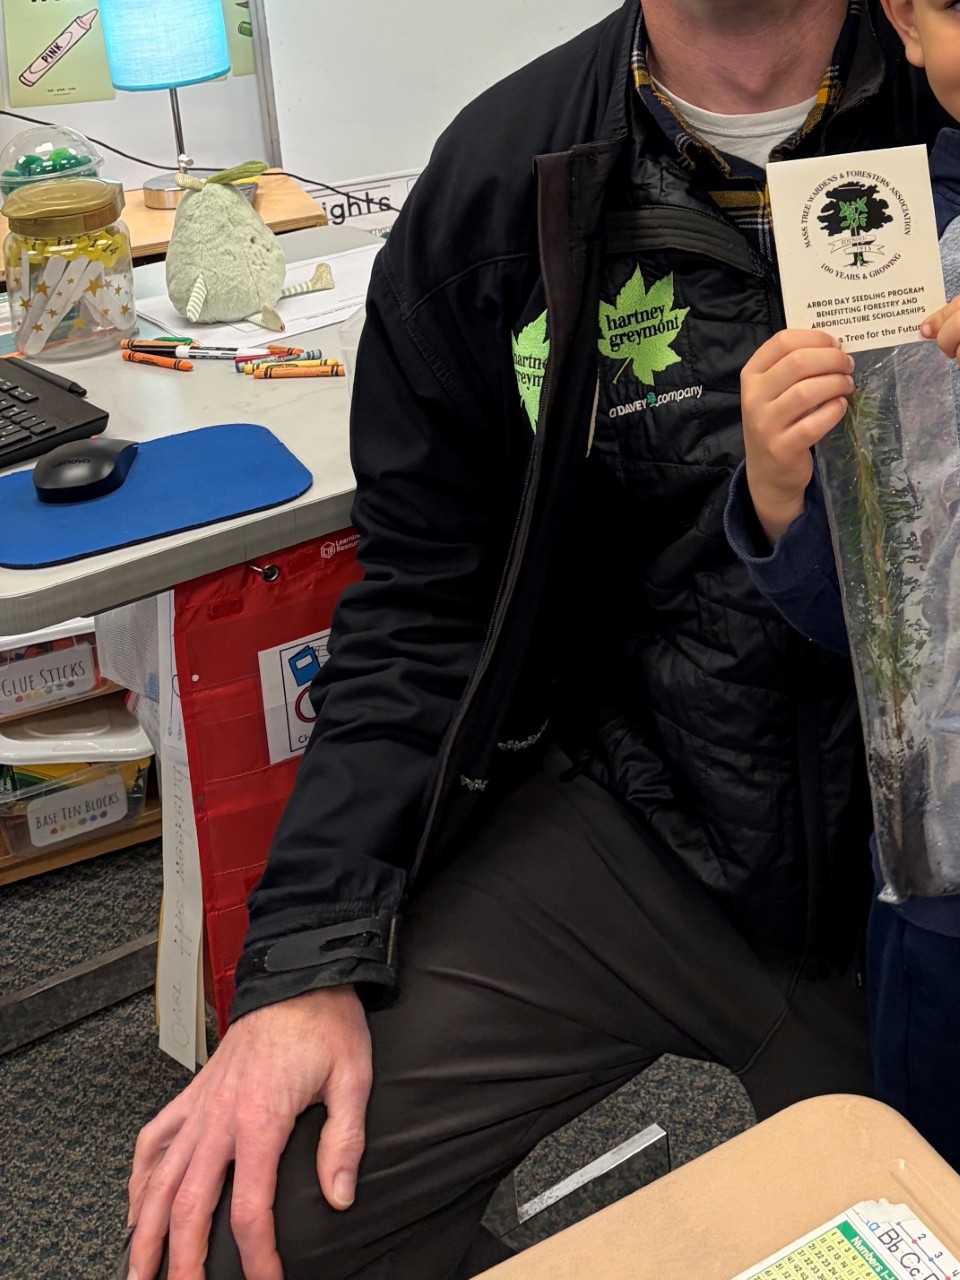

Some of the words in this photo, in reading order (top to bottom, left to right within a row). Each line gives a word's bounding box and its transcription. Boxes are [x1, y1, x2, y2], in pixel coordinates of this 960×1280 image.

[41, 41, 64, 65] PINK
[809, 173, 838, 203] WARDENS
[846, 170, 890, 188] FORESTERS
[801, 203, 812, 224] TREE
[889, 186, 912, 236] ASSOCIATION
[801, 224, 812, 249] MASS
[820, 262, 834, 275] 100
[835, 270, 861, 281] YEARS
[869, 252, 902, 279] GROWING
[807, 298, 833, 309] ARBOR
[834, 296, 850, 307] DAY
[852, 292, 886, 303] SEEDLING
[888, 286, 925, 297] PROGRAM
[816, 306, 862, 318] BENEFITTING
[863, 300, 900, 312] FORESTRY
[902, 297, 918, 306] AND
[605, 304, 666, 331] hartney
[811, 315, 870, 329] ARBORICULTURE
[872, 306, 926, 321] SCHOLARSHIPS
[609, 316, 680, 352] greymont
[844, 332, 865, 343] Tree
[866, 330, 880, 339] for
[881, 327, 896, 336] the
[898, 324, 922, 334] Futur
[657, 385, 703, 406] company
[1, 673, 36, 697] GLUE
[39, 660, 86, 685] STICKS
[35, 813, 58, 830] BASE
[61, 805, 82, 819] TEN
[85, 791, 120, 812] BLOCKS
[851, 1236, 883, 1272] Numbers
[877, 1228, 904, 1253] Bb
[900, 1253, 920, 1277] Cc
